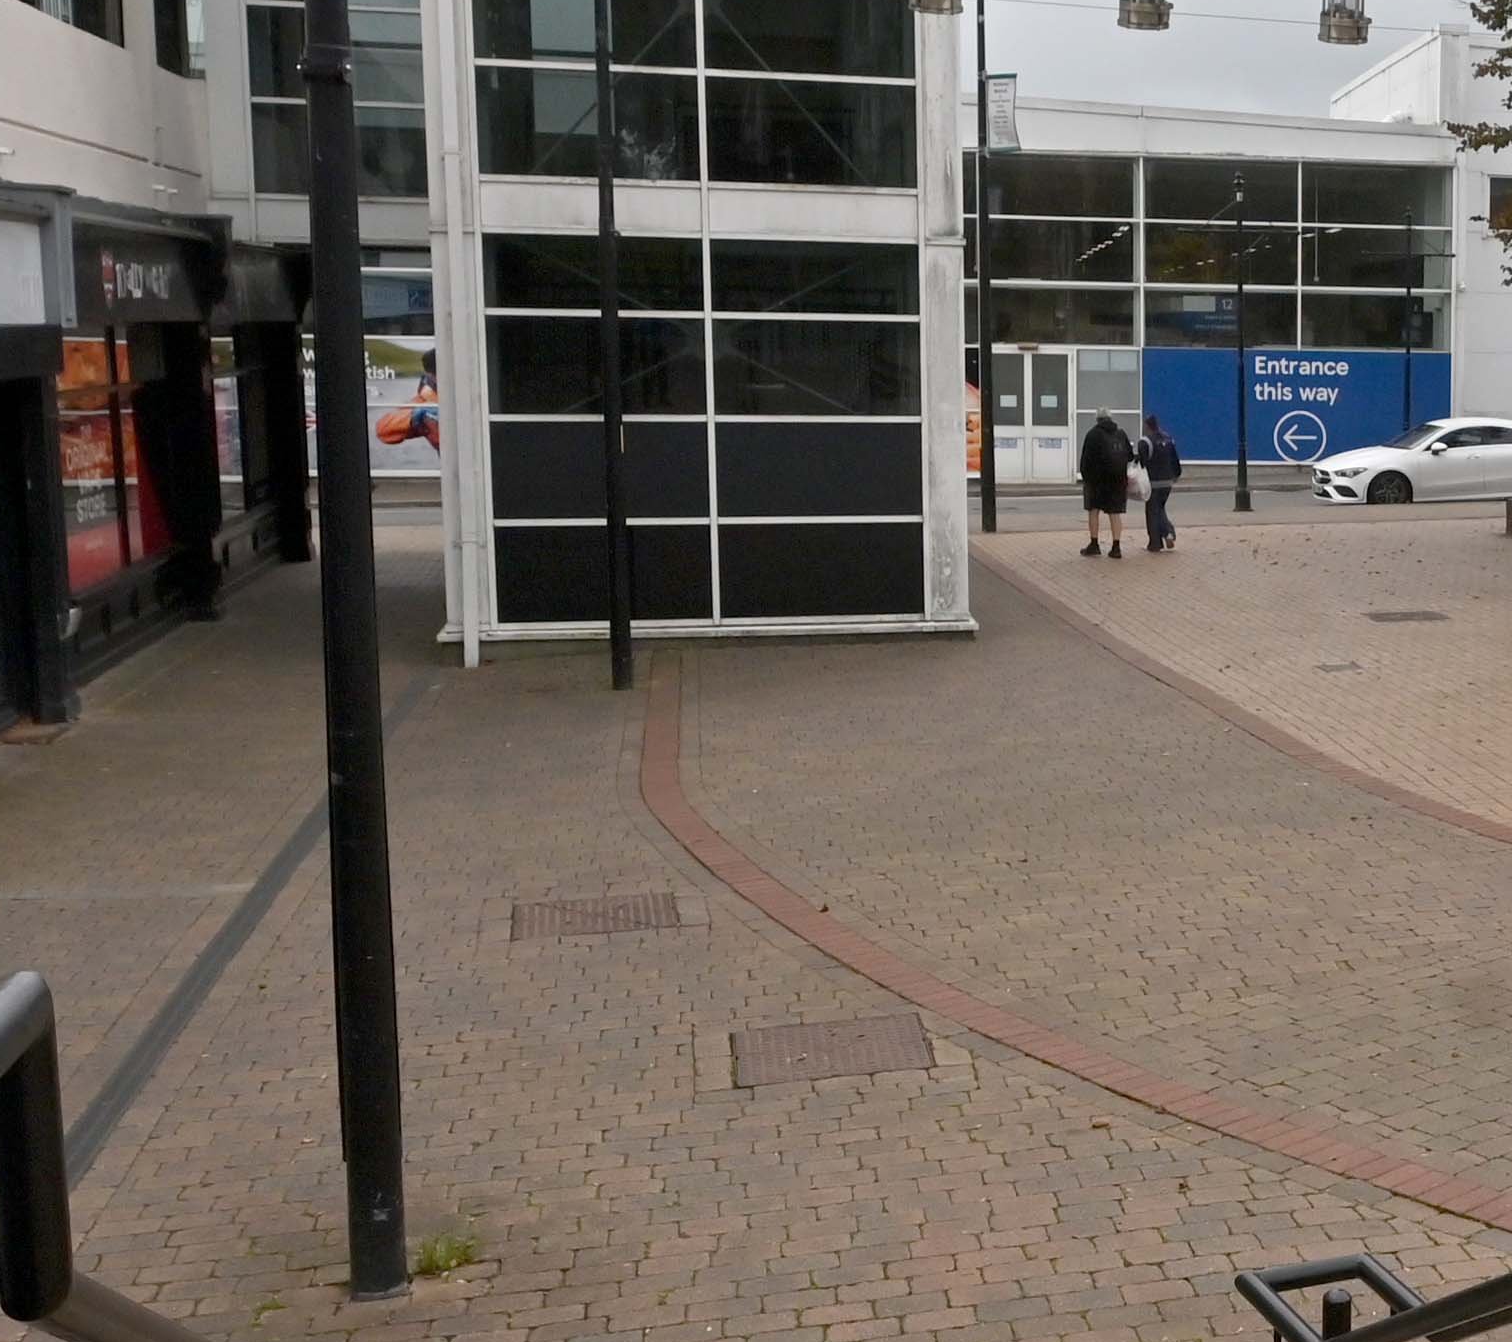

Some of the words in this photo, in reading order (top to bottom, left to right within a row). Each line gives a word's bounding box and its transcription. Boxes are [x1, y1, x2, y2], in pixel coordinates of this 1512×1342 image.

[1221, 298, 1233, 310] 12
[1254, 355, 1349, 376] Entrance
[1254, 382, 1292, 401] this
[1299, 387, 1339, 406] way
